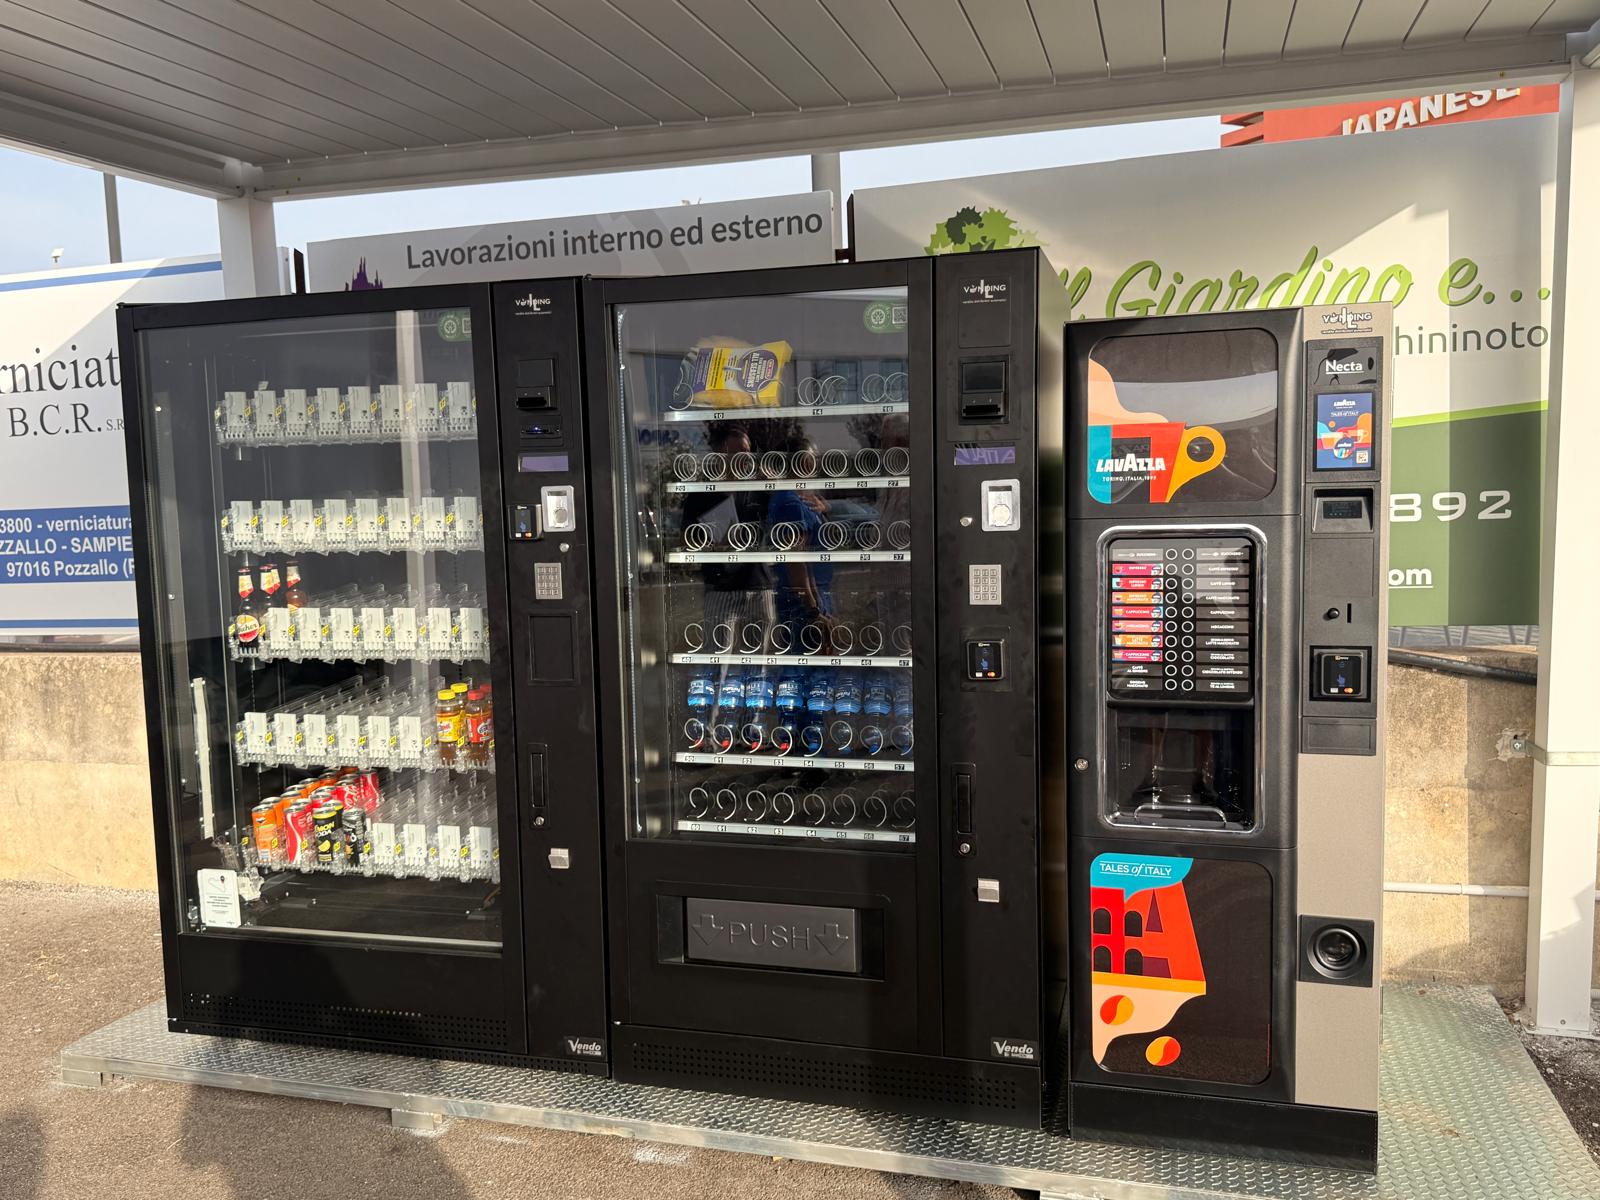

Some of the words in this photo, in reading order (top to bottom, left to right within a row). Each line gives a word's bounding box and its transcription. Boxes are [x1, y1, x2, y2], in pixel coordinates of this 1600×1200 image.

[407, 231, 556, 269] Lavorazioni
[563, 225, 664, 257] interno
[670, 216, 703, 248] ed
[711, 212, 823, 244] esterno
[1059, 266, 1092, 320] l
[1105, 246, 1415, 320] Giardino
[1395, 321, 1550, 357] hininoto
[1325, 360, 1363, 373] Necta
[7, 403, 102, 437] B.C.R.
[1096, 453, 1166, 472] LAVAZZA
[1390, 490, 1512, 522] 892
[46, 515, 132, 532] verniciatur
[71, 536, 133, 553] SAMPIE
[7, 561, 50, 577] 97016
[54, 559, 118, 576] Pozzallo
[1388, 568, 1433, 587] om
[1100, 863, 1129, 873] TALES
[1131, 863, 1145, 877] of
[1145, 866, 1172, 876] ITALY
[729, 921, 810, 950] PUSH
[568, 1038, 601, 1052] Vendo
[993, 1040, 1033, 1054] Vendo
